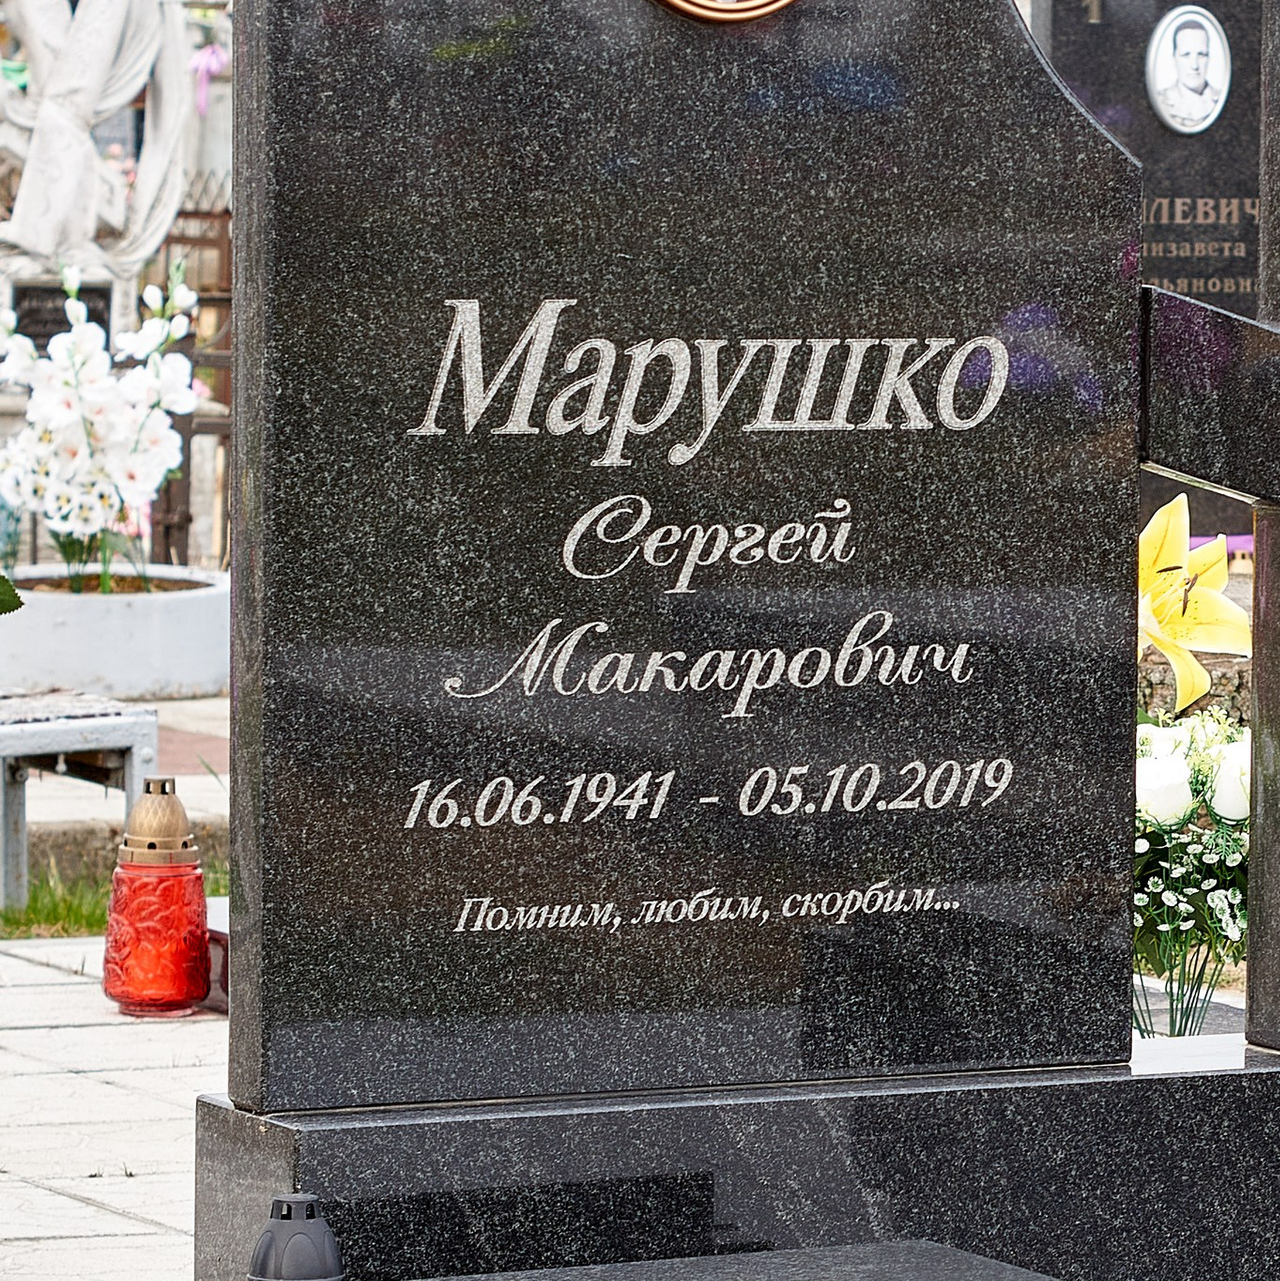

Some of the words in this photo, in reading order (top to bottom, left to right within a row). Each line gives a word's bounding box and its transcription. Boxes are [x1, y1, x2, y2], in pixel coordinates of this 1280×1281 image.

[1143, 197, 1260, 224] ЛЕВИЧ
[1143, 241, 1247, 258] изавета
[406, 298, 1009, 468] Марушко
[562, 494, 856, 594] Сергей
[443, 610, 975, 718] Макарович
[403, 768, 677, 830] 16.06.1941
[738, 757, 1014, 818] 05.10.2019
[453, 896, 622, 934] Помним,
[630, 886, 769, 926] любим,
[782, 880, 961, 924] скорбим...
